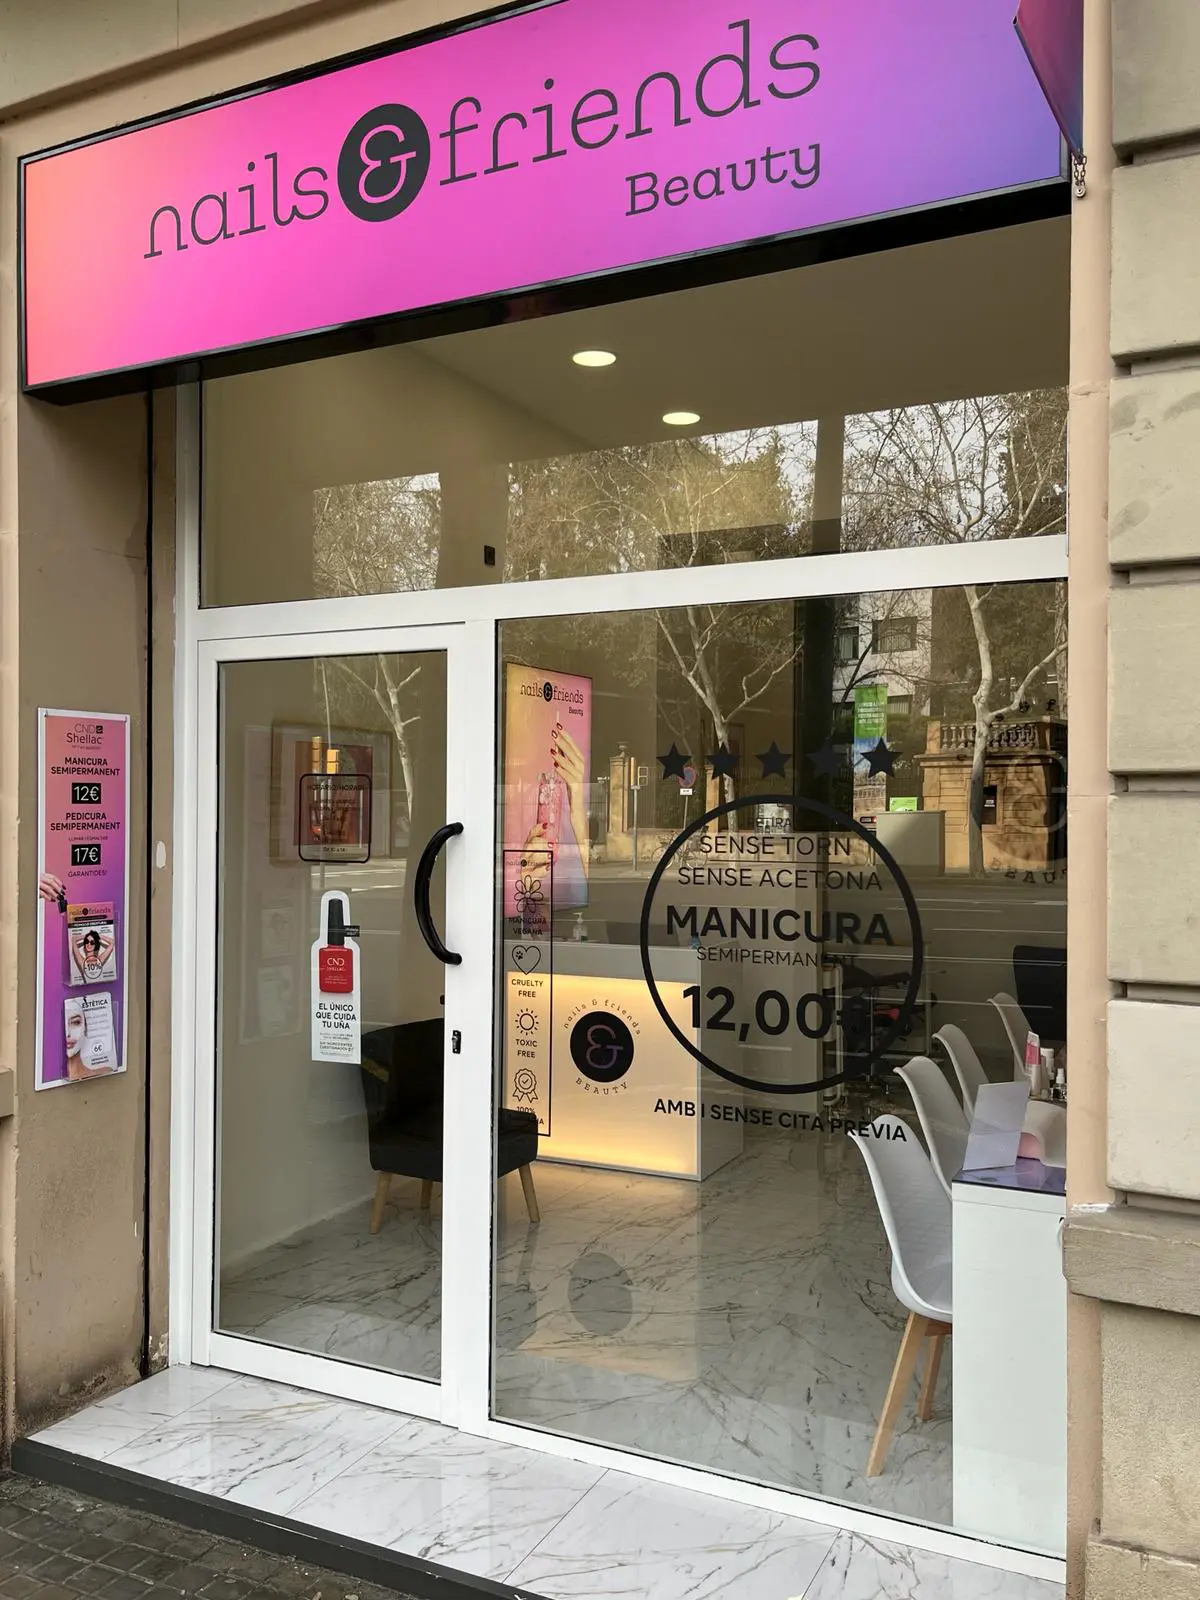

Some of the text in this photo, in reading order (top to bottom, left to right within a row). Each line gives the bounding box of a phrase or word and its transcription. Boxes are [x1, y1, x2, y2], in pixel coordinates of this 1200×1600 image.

[625, 143, 821, 216] Beauty
[66, 732, 102, 745] Shellac
[64, 756, 108, 766] MANICURA
[50, 766, 121, 776] SEMIPERMANENT
[73, 785, 99, 802] 12€
[65, 812, 107, 821] PEDICURA
[50, 822, 121, 831] SEMIPERMANENT
[700, 834, 851, 857] SENSE TORN
[74, 846, 99, 864] 17€
[678, 867, 882, 891] SENSE ACETONA
[508, 916, 547, 925] MANICURA
[666, 904, 895, 946] MANICURA
[326, 957, 345, 966] CND
[511, 978, 544, 987] CRUELTY
[518, 990, 537, 998] FREE
[319, 1001, 354, 1012] EL ÚNICO
[315, 1011, 357, 1021] QUE CUIDA
[564, 1003, 587, 1030] nails
[604, 999, 641, 1036] friends
[322, 1020, 350, 1029] TU UÑA
[515, 1038, 538, 1048] TOXIC
[517, 1050, 536, 1059] FREE
[575, 1076, 628, 1095] BEAUTY
[654, 1098, 696, 1117] AMB
[710, 1104, 773, 1126] SENSE
[778, 1112, 824, 1132] CITA
[830, 1114, 908, 1142] PRÈVIA
